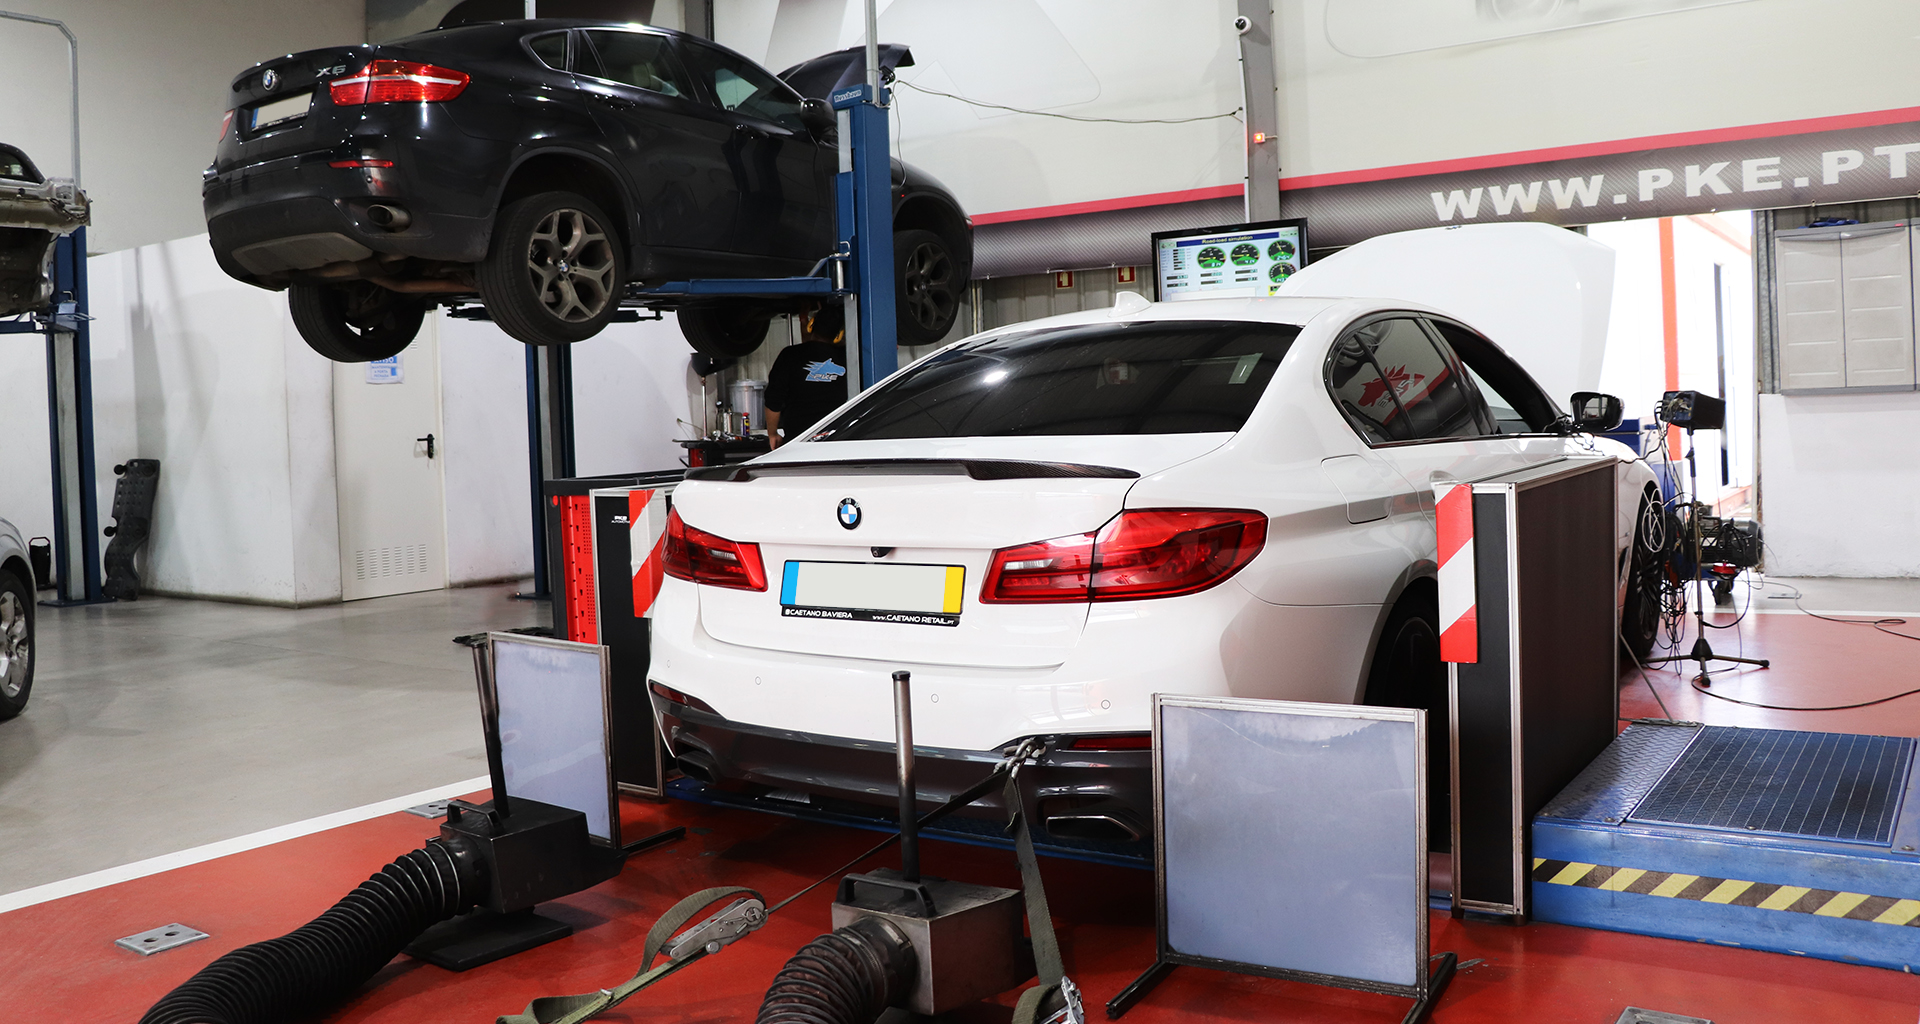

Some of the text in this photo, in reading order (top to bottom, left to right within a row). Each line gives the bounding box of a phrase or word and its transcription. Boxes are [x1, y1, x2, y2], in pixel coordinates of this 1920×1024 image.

[315, 64, 346, 78] X6
[1431, 142, 1920, 221] WWW.PKE.PT
[821, 610, 853, 619] BAVIERA
